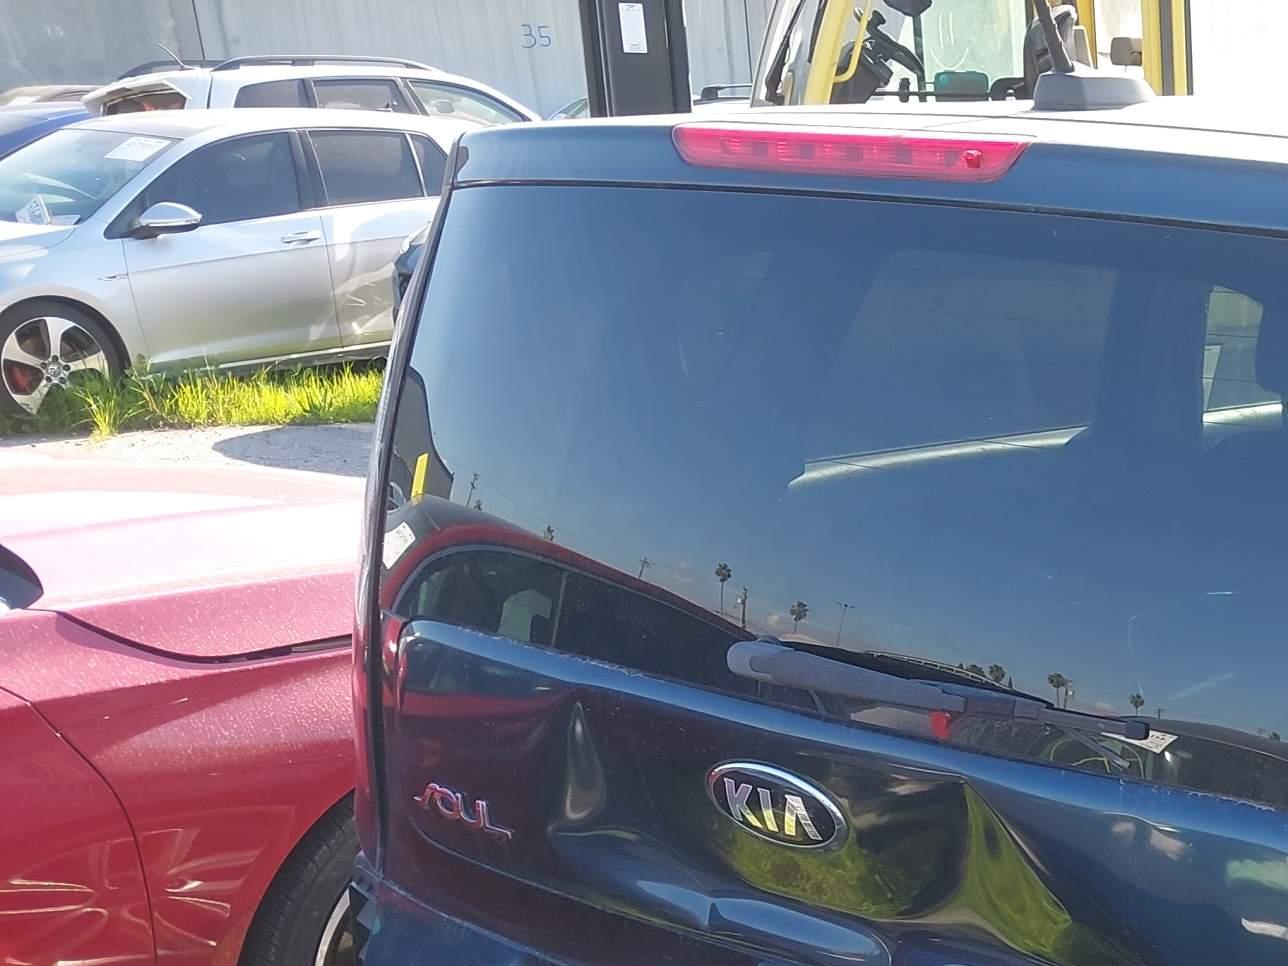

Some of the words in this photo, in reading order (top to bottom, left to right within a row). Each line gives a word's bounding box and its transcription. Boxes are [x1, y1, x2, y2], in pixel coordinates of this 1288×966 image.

[520, 23, 551, 48] 35
[413, 782, 513, 840] SOUL
[723, 777, 824, 841] KIA
